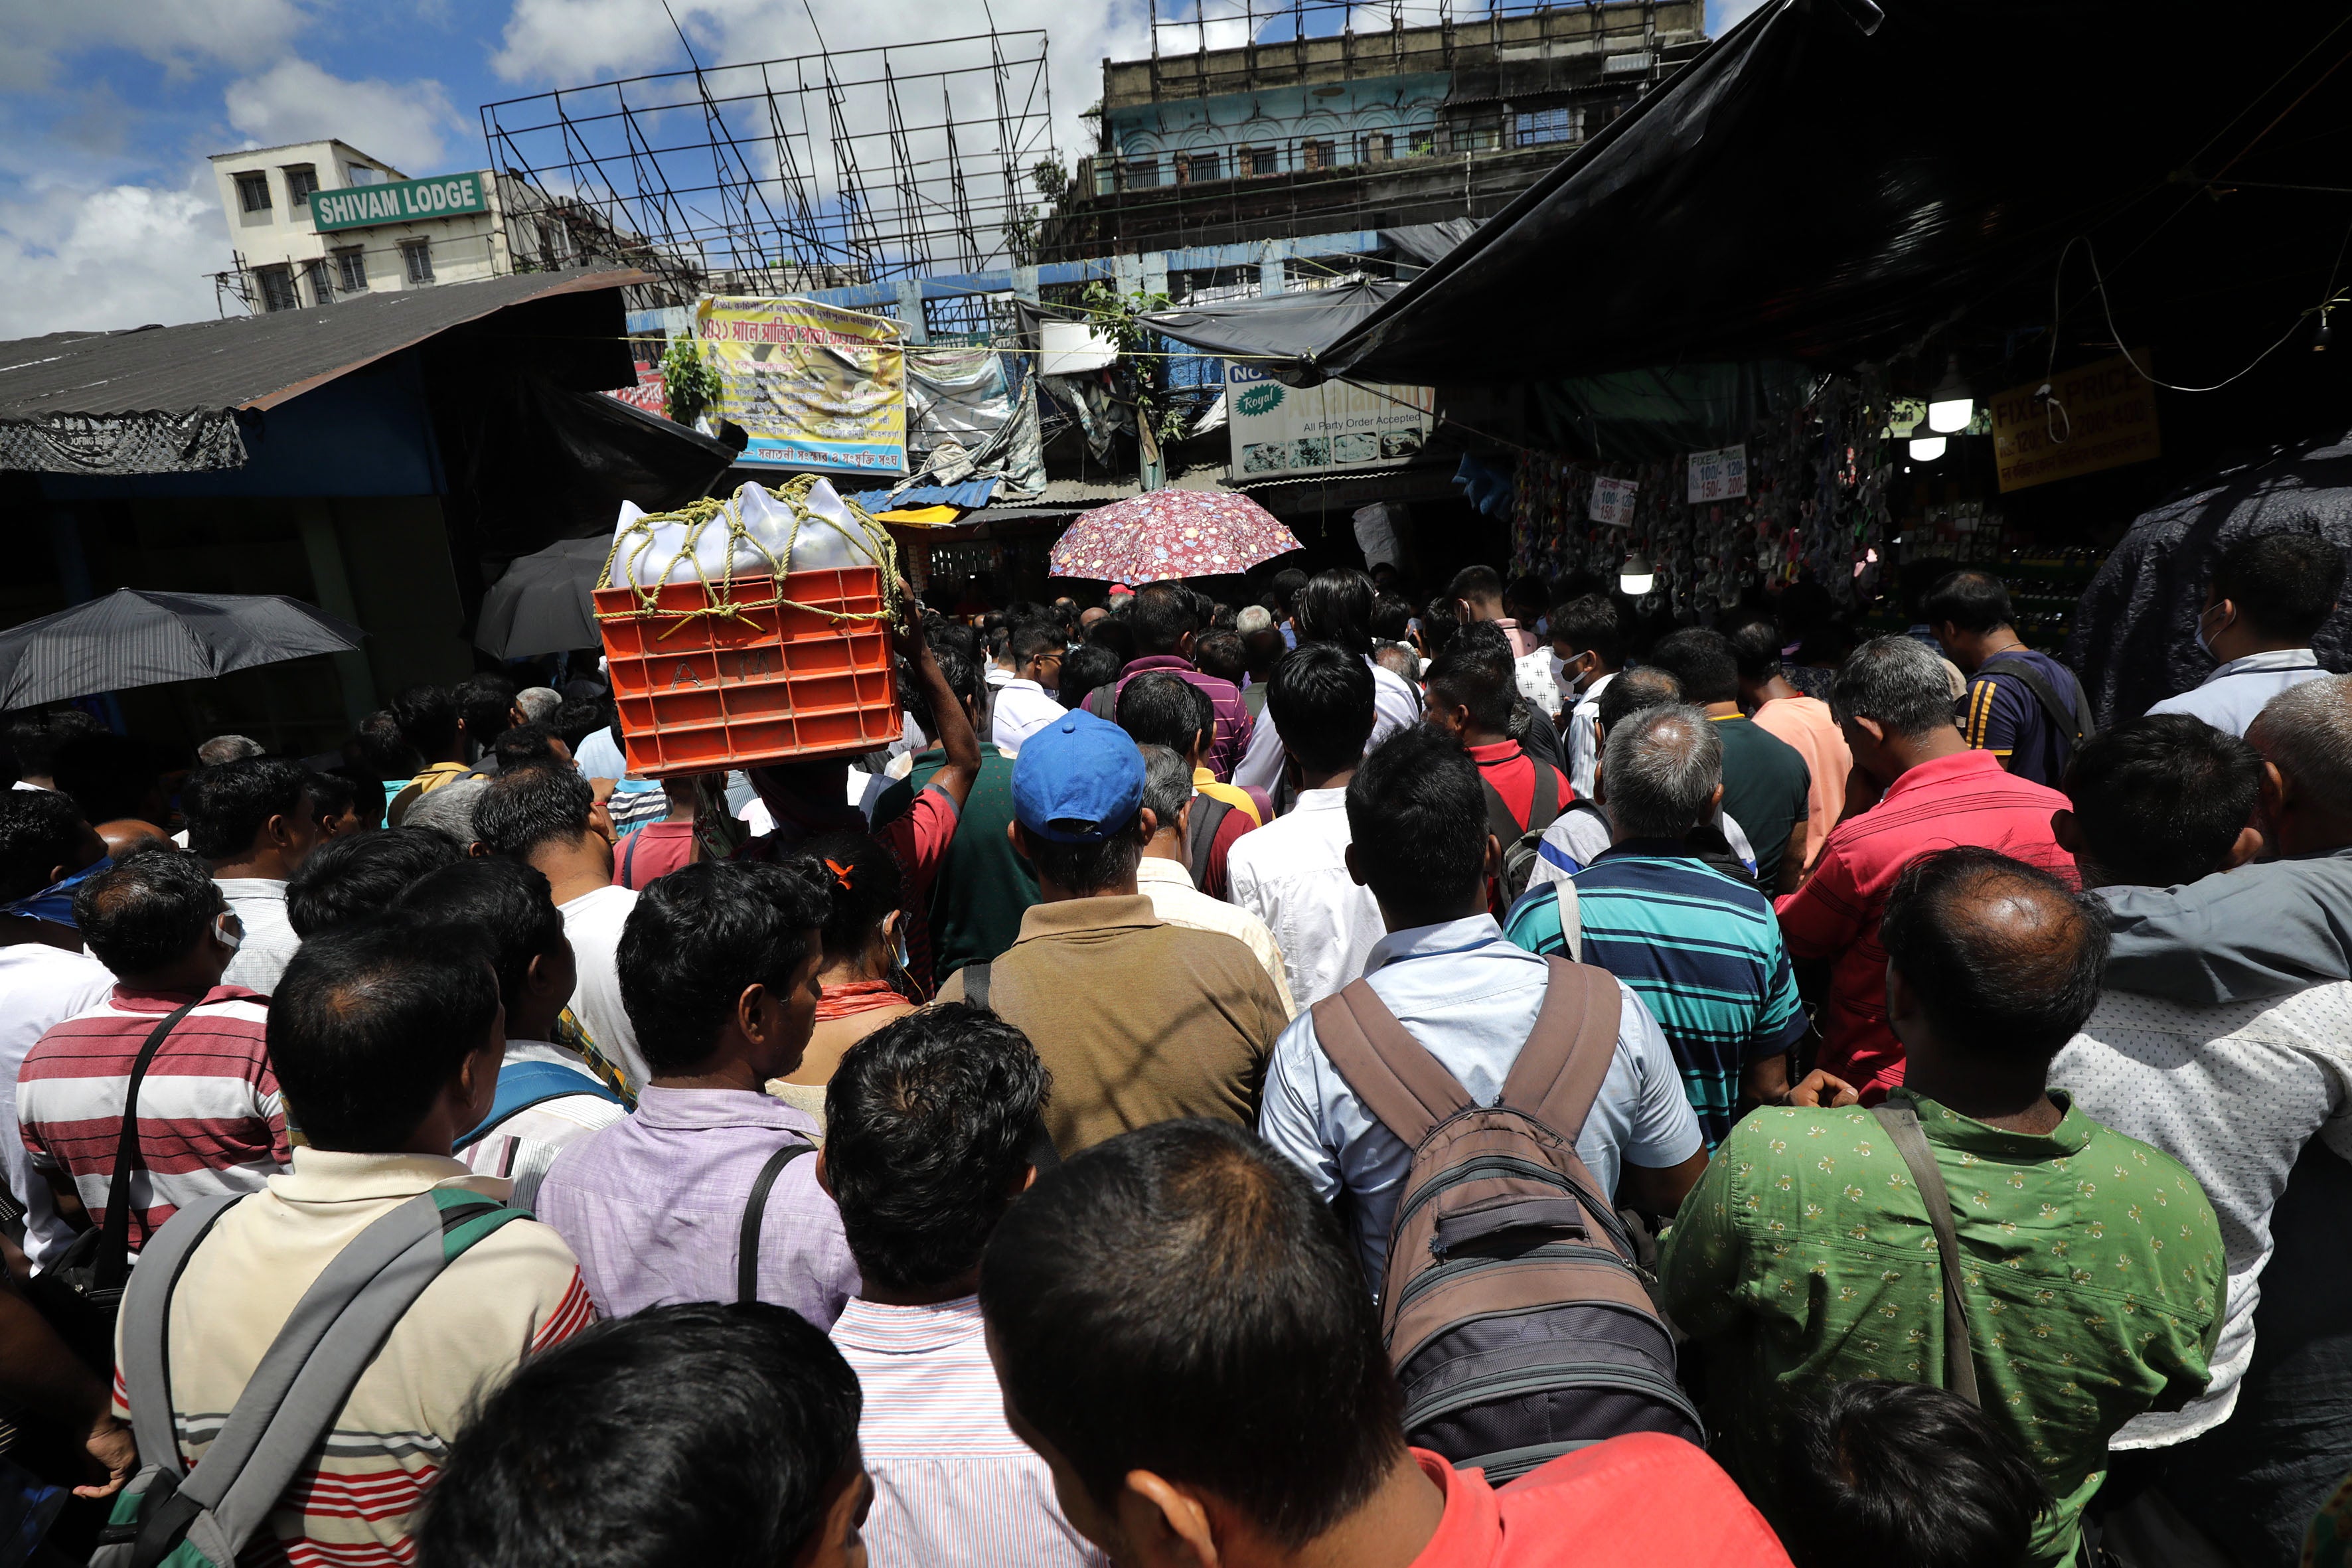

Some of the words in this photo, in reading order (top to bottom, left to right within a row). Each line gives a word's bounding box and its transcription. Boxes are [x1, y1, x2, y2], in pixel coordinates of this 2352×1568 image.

[319, 189, 401, 224] SHIVAM
[403, 179, 476, 214] LODGE
[700, 319, 729, 341] ২০২১
[732, 321, 759, 342] সালে
[2065, 364, 2140, 408] PRICE
[1243, 387, 1274, 410] Royal
[1304, 423, 1316, 432] All
[1318, 420, 1344, 431] Party
[1346, 418, 1373, 428] Order
[1376, 413, 1421, 425] Accepted
[758, 446, 795, 460] সনাতনী
[797, 450, 828, 463] সংস্কার
[832, 453, 838, 463] ও
[878, 454, 898, 465] সংঘ
[1691, 453, 1717, 467] FIXED
[1700, 464, 1722, 481] 100/-
[1727, 459, 1746, 477] 120/-
[1602, 491, 1619, 505] 100/-
[1701, 479, 1721, 499] 150/-
[1727, 475, 1747, 495] 200/-
